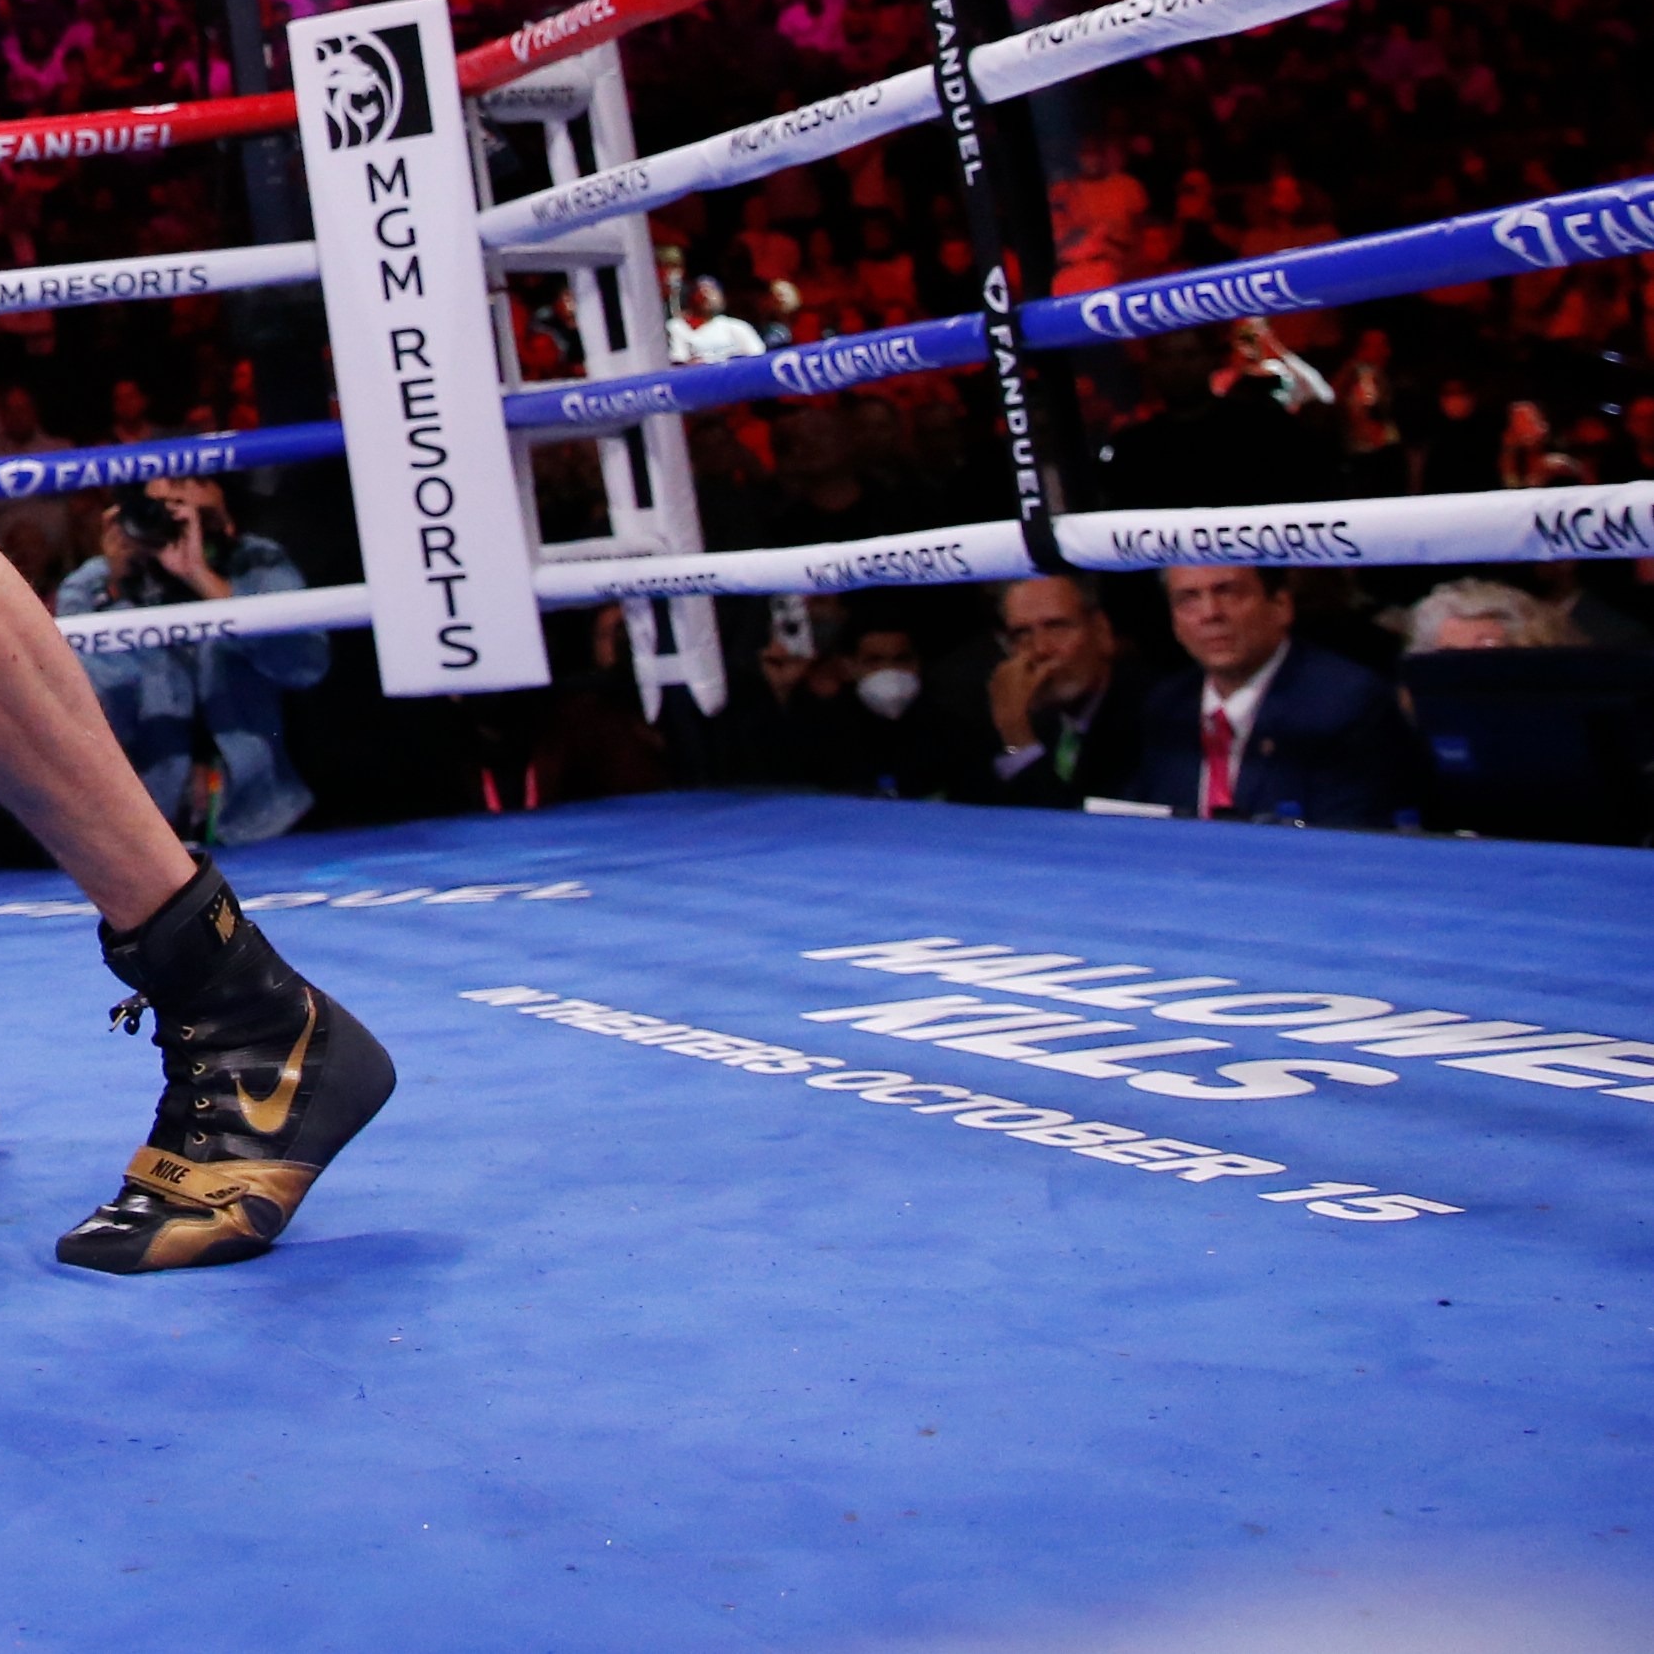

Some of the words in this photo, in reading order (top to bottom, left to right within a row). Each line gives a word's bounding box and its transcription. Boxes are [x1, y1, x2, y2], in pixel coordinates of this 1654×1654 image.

[365, 156, 424, 303] MGM
[40, 265, 210, 303] RESORTS
[1125, 267, 1324, 331] FANDUEL
[989, 325, 1048, 523] FANDUEL
[53, 447, 240, 489] FANDUEL
[389, 326, 481, 669] RESORTS
[1111, 527, 1181, 566] MGM
[1192, 518, 1363, 565] RESORTS
[1533, 503, 1643, 555] MGM
[800, 993, 1402, 1100] KILLS
[517, 998, 847, 1074] THEATERS
[805, 1069, 1288, 1183] OCTOBER
[1256, 1181, 1466, 1223] 15
[149, 1157, 191, 1185] NIKE
